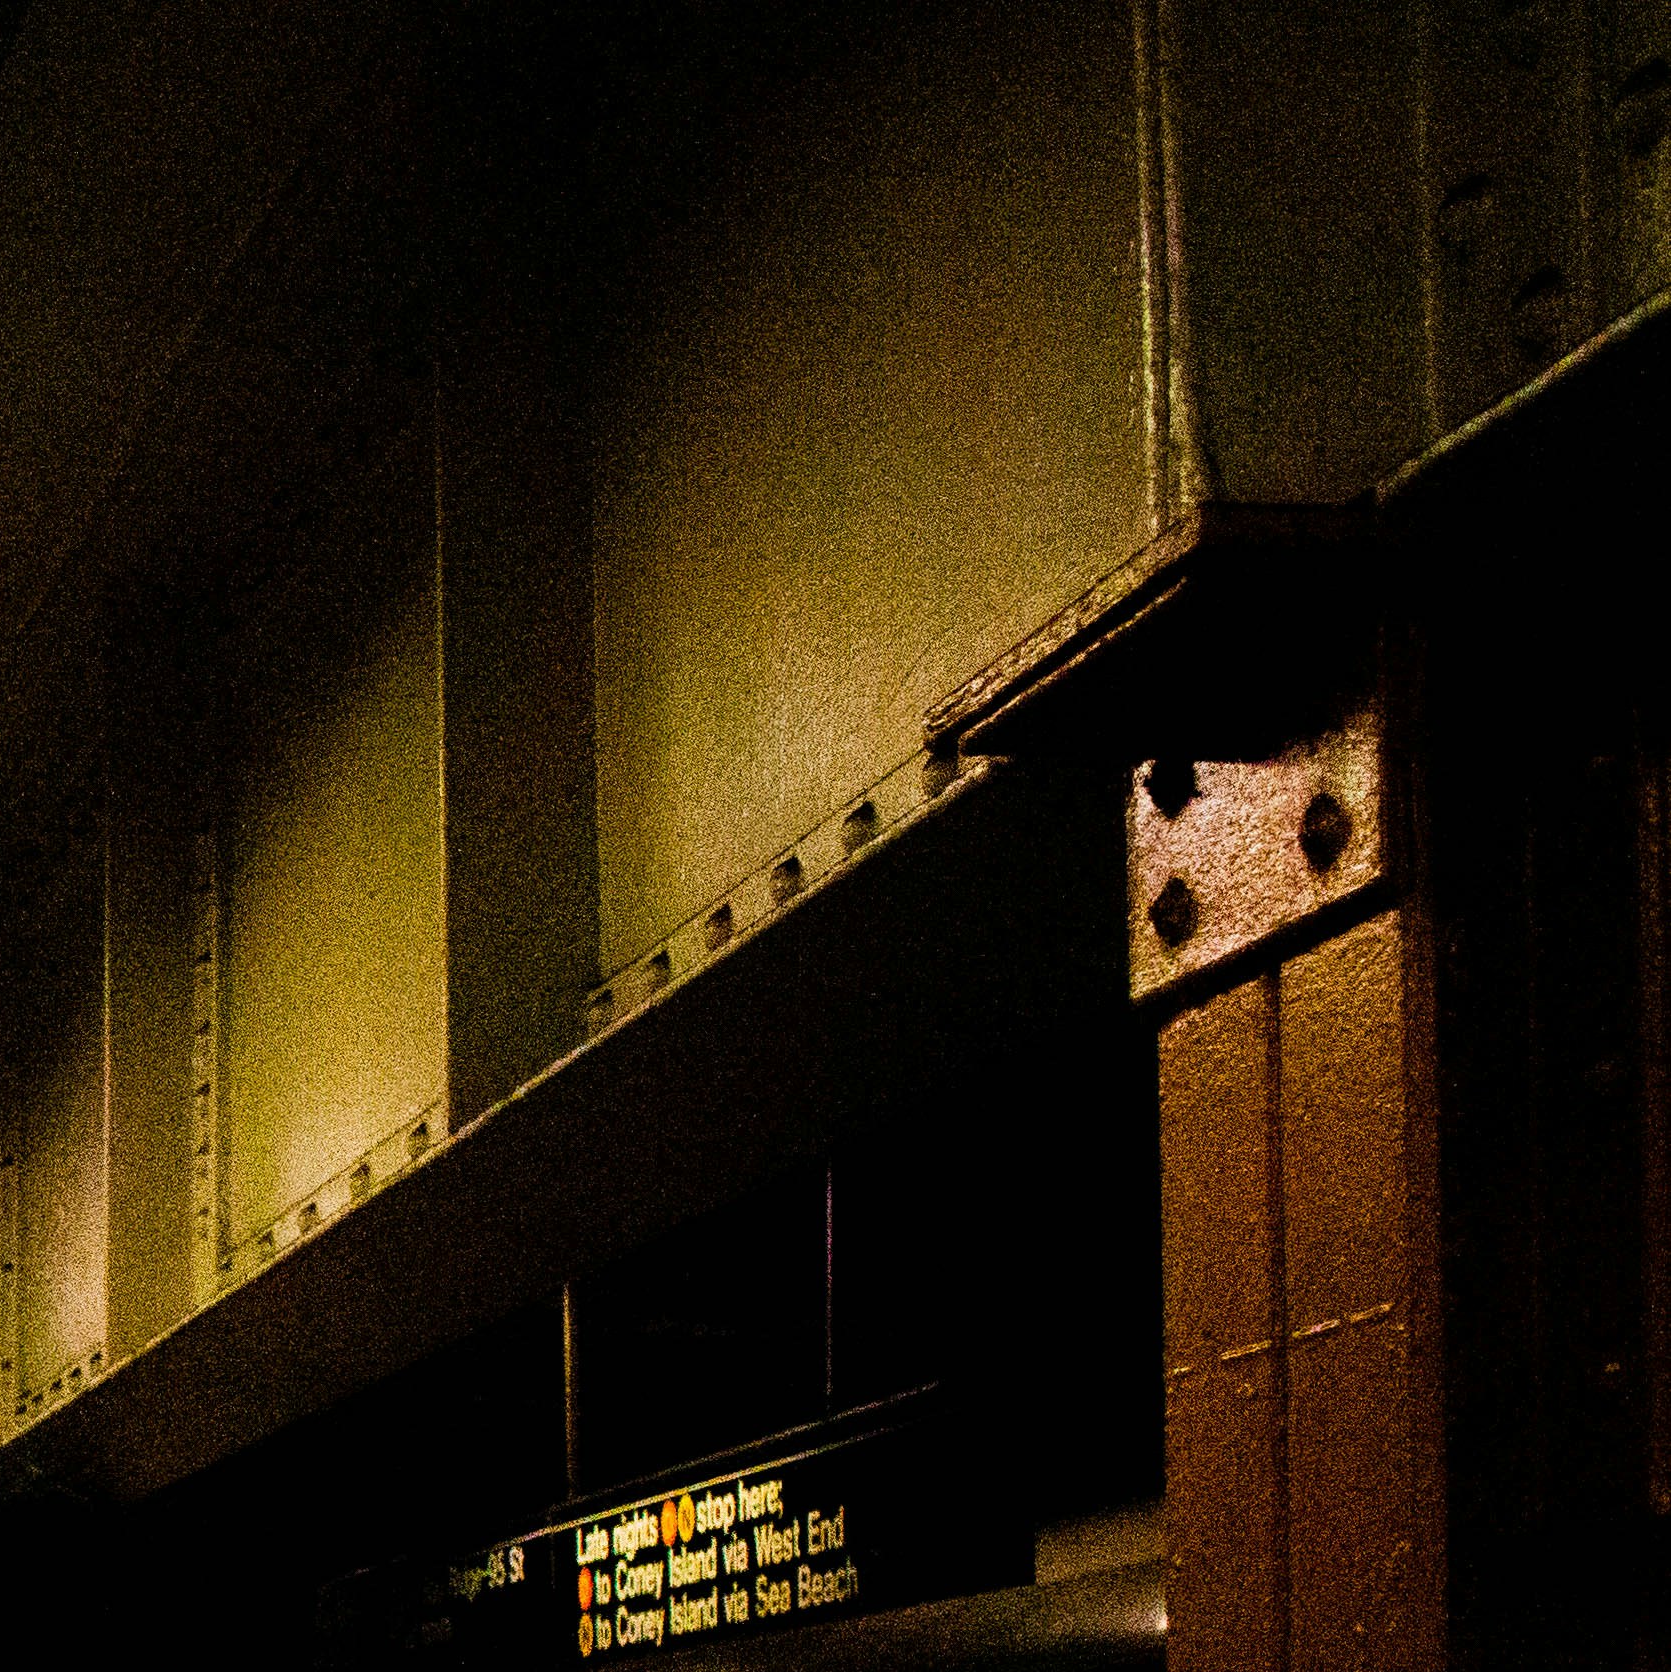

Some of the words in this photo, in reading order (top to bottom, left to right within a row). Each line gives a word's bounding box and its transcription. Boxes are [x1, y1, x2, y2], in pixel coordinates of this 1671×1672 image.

[576, 1525, 609, 1565] Late
[612, 1509, 659, 1562] nights
[695, 1490, 737, 1535] stop
[594, 1569, 612, 1605] to
[614, 1559, 665, 1601] Coney
[667, 1535, 718, 1589] Island
[722, 1530, 750, 1575] via
[753, 1516, 801, 1568] West
[806, 1503, 845, 1556] End
[595, 1612, 613, 1651] to
[615, 1603, 666, 1648] Coney
[668, 1584, 719, 1636] Island
[724, 1579, 751, 1626] via
[755, 1572, 793, 1619] Sea
[796, 1554, 860, 1610] Beach
